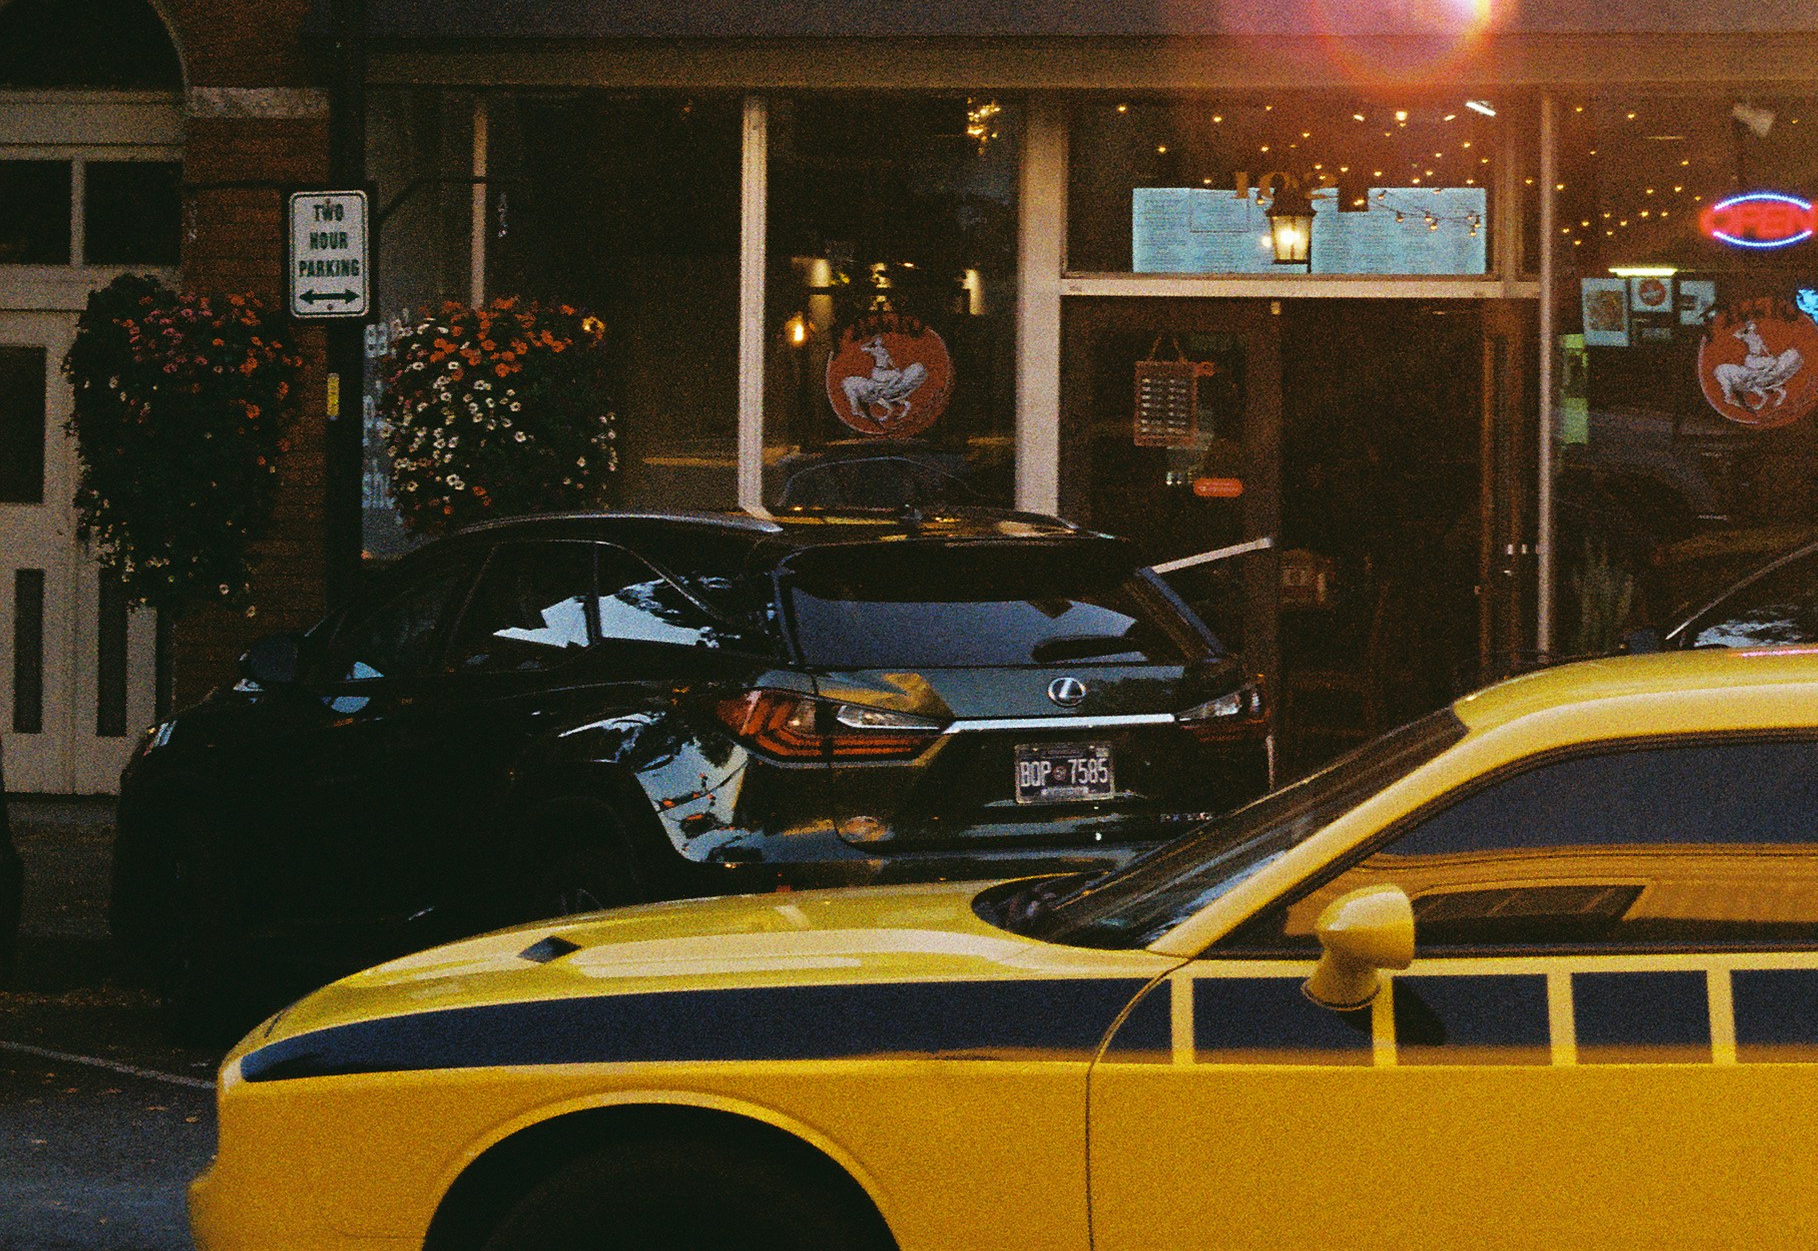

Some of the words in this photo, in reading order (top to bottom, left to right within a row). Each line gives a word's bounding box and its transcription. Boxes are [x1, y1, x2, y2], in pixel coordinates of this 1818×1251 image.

[313, 204, 345, 222] TWO
[310, 232, 349, 249] HOUR
[299, 259, 360, 277] PARKING
[1067, 758, 1109, 785] 7585
